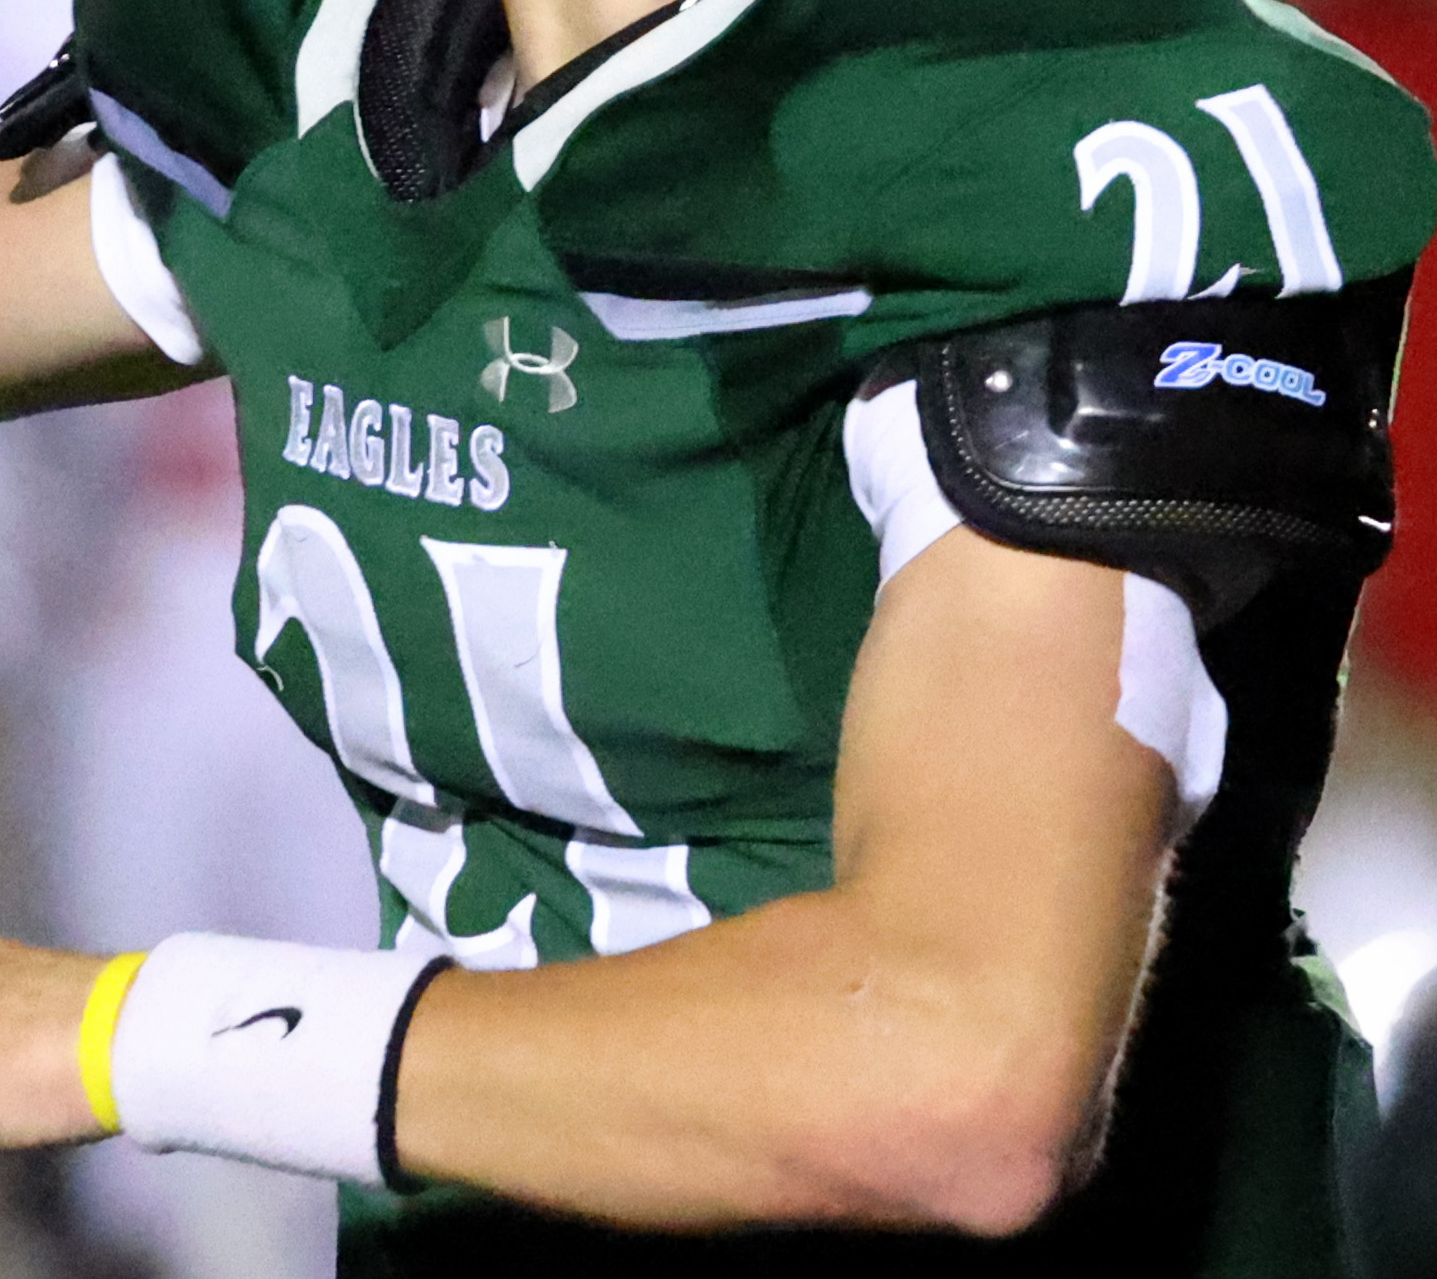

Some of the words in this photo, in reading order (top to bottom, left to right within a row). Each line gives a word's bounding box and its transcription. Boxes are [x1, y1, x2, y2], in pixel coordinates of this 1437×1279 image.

[1074, 83, 1343, 307] 21
[282, 375, 510, 512] EAGLES
[254, 504, 712, 971] 21
